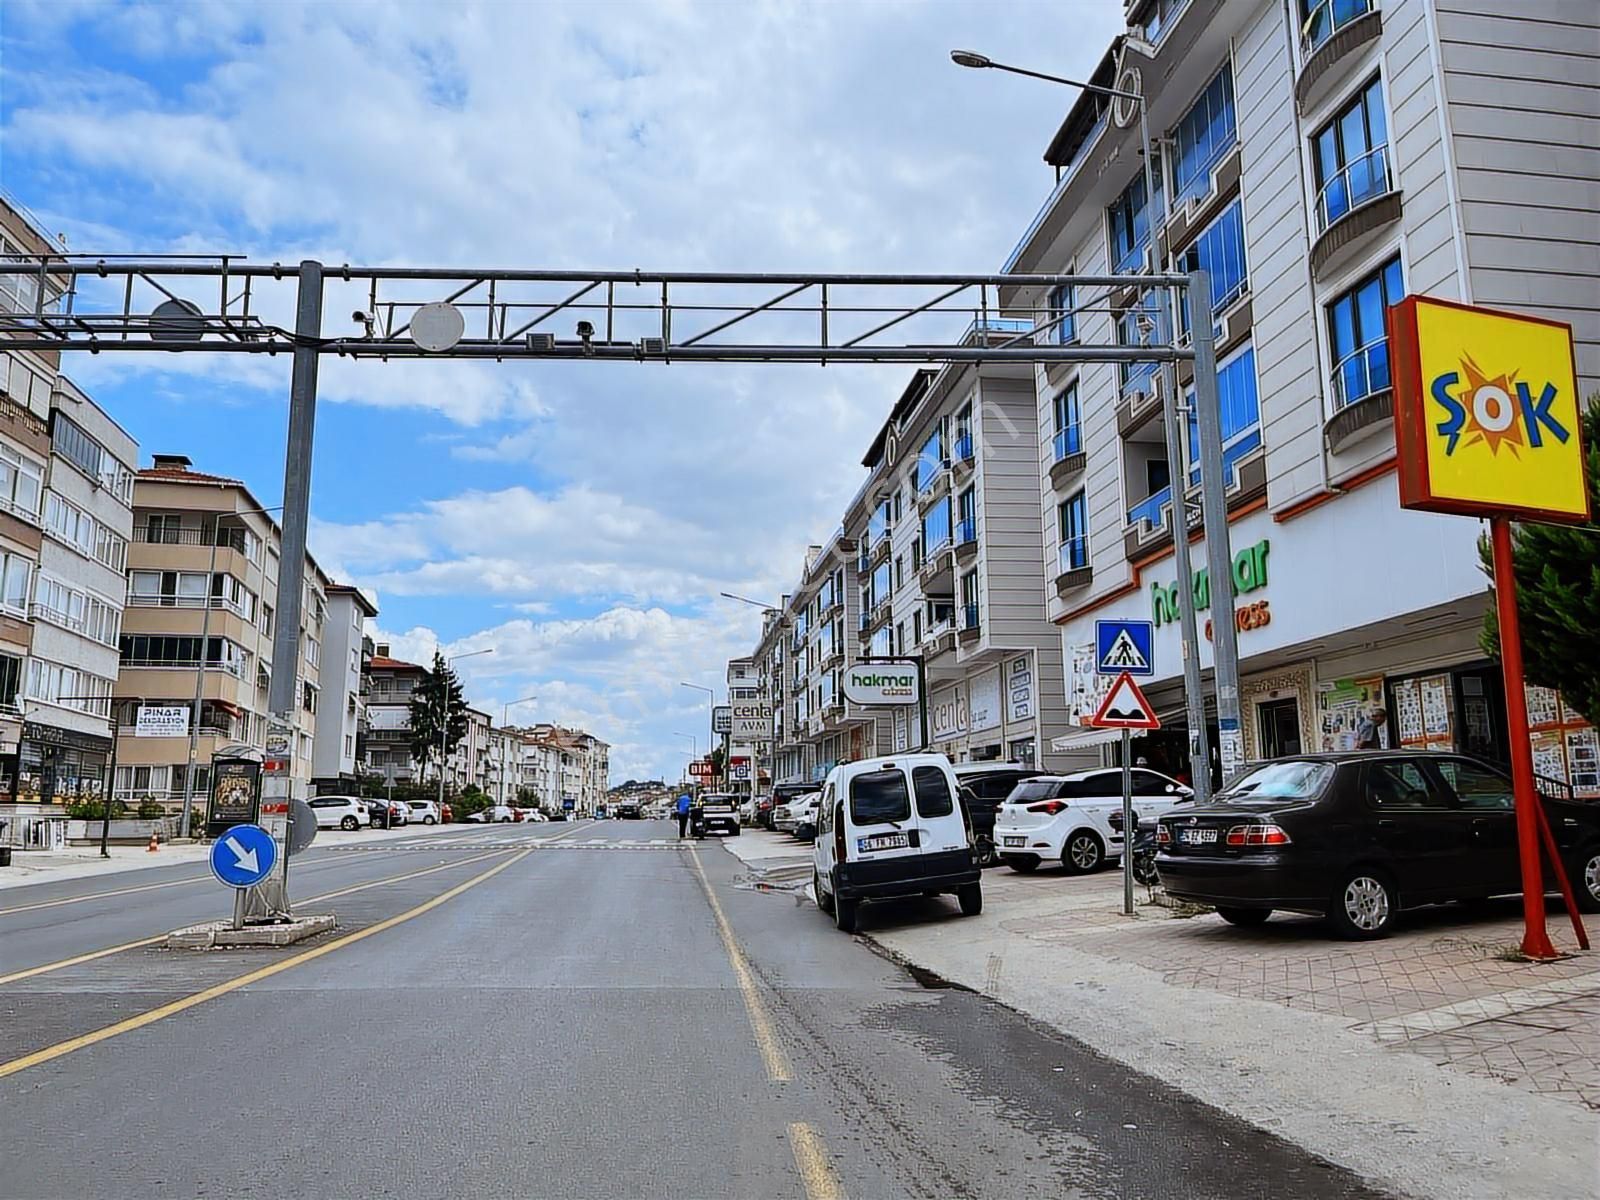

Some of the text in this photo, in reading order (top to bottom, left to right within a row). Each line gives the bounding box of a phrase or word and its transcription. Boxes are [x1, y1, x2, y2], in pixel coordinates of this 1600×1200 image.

[1431, 371, 1570, 457] ŞOK
[1151, 539, 1270, 628] haar
[1204, 600, 1271, 642] eress
[851, 673, 914, 687] hakmar
[144, 708, 181, 717] PINAR
[733, 702, 772, 719] centa
[933, 687, 968, 732] centa
[740, 721, 766, 731] AVM
